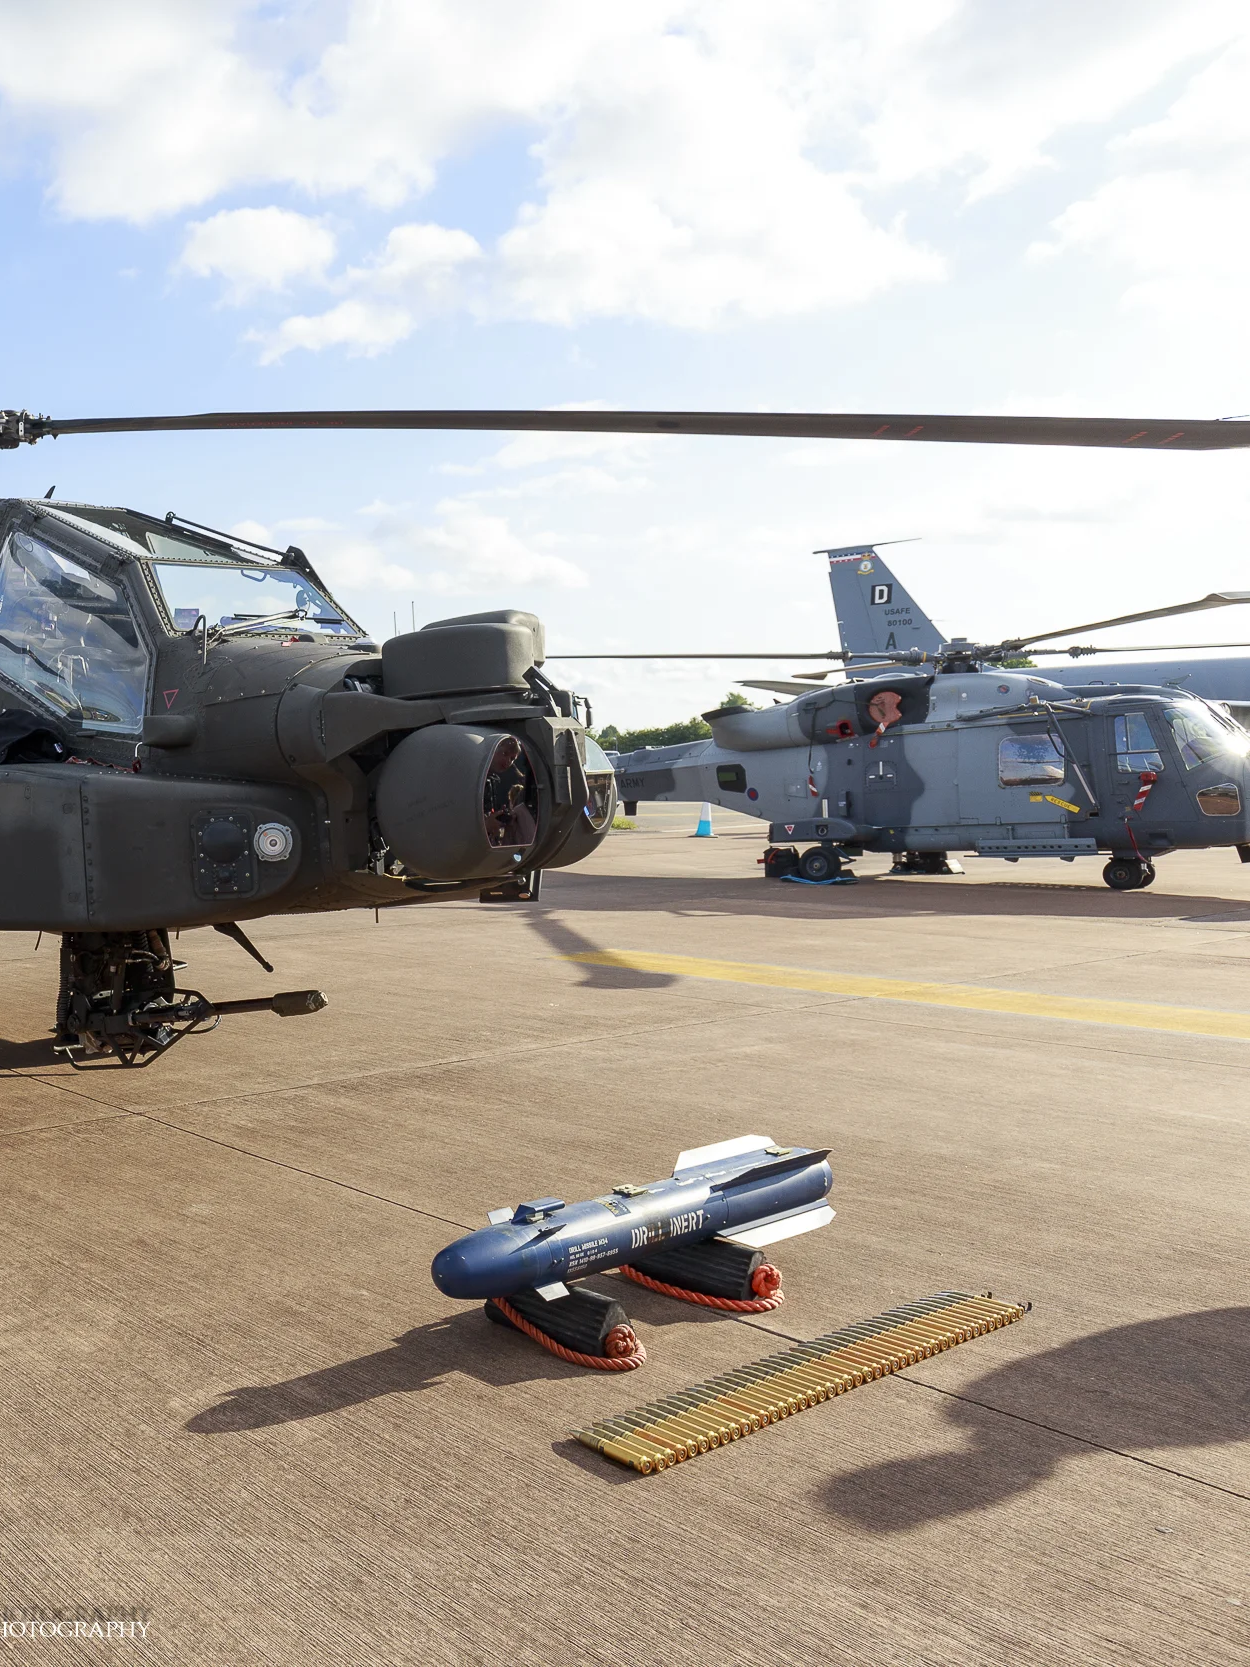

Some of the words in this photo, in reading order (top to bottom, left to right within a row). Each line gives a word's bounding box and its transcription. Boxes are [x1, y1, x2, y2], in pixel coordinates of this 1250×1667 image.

[874, 585, 888, 604] D
[884, 607, 910, 616] USAFE
[887, 618, 913, 627] 80100
[885, 631, 897, 650] A
[620, 776, 645, 789] ARMY
[1050, 797, 1071, 809] RESCUE
[670, 1209, 704, 1237] INERT
[581, 1240, 598, 1250] MISSILE
